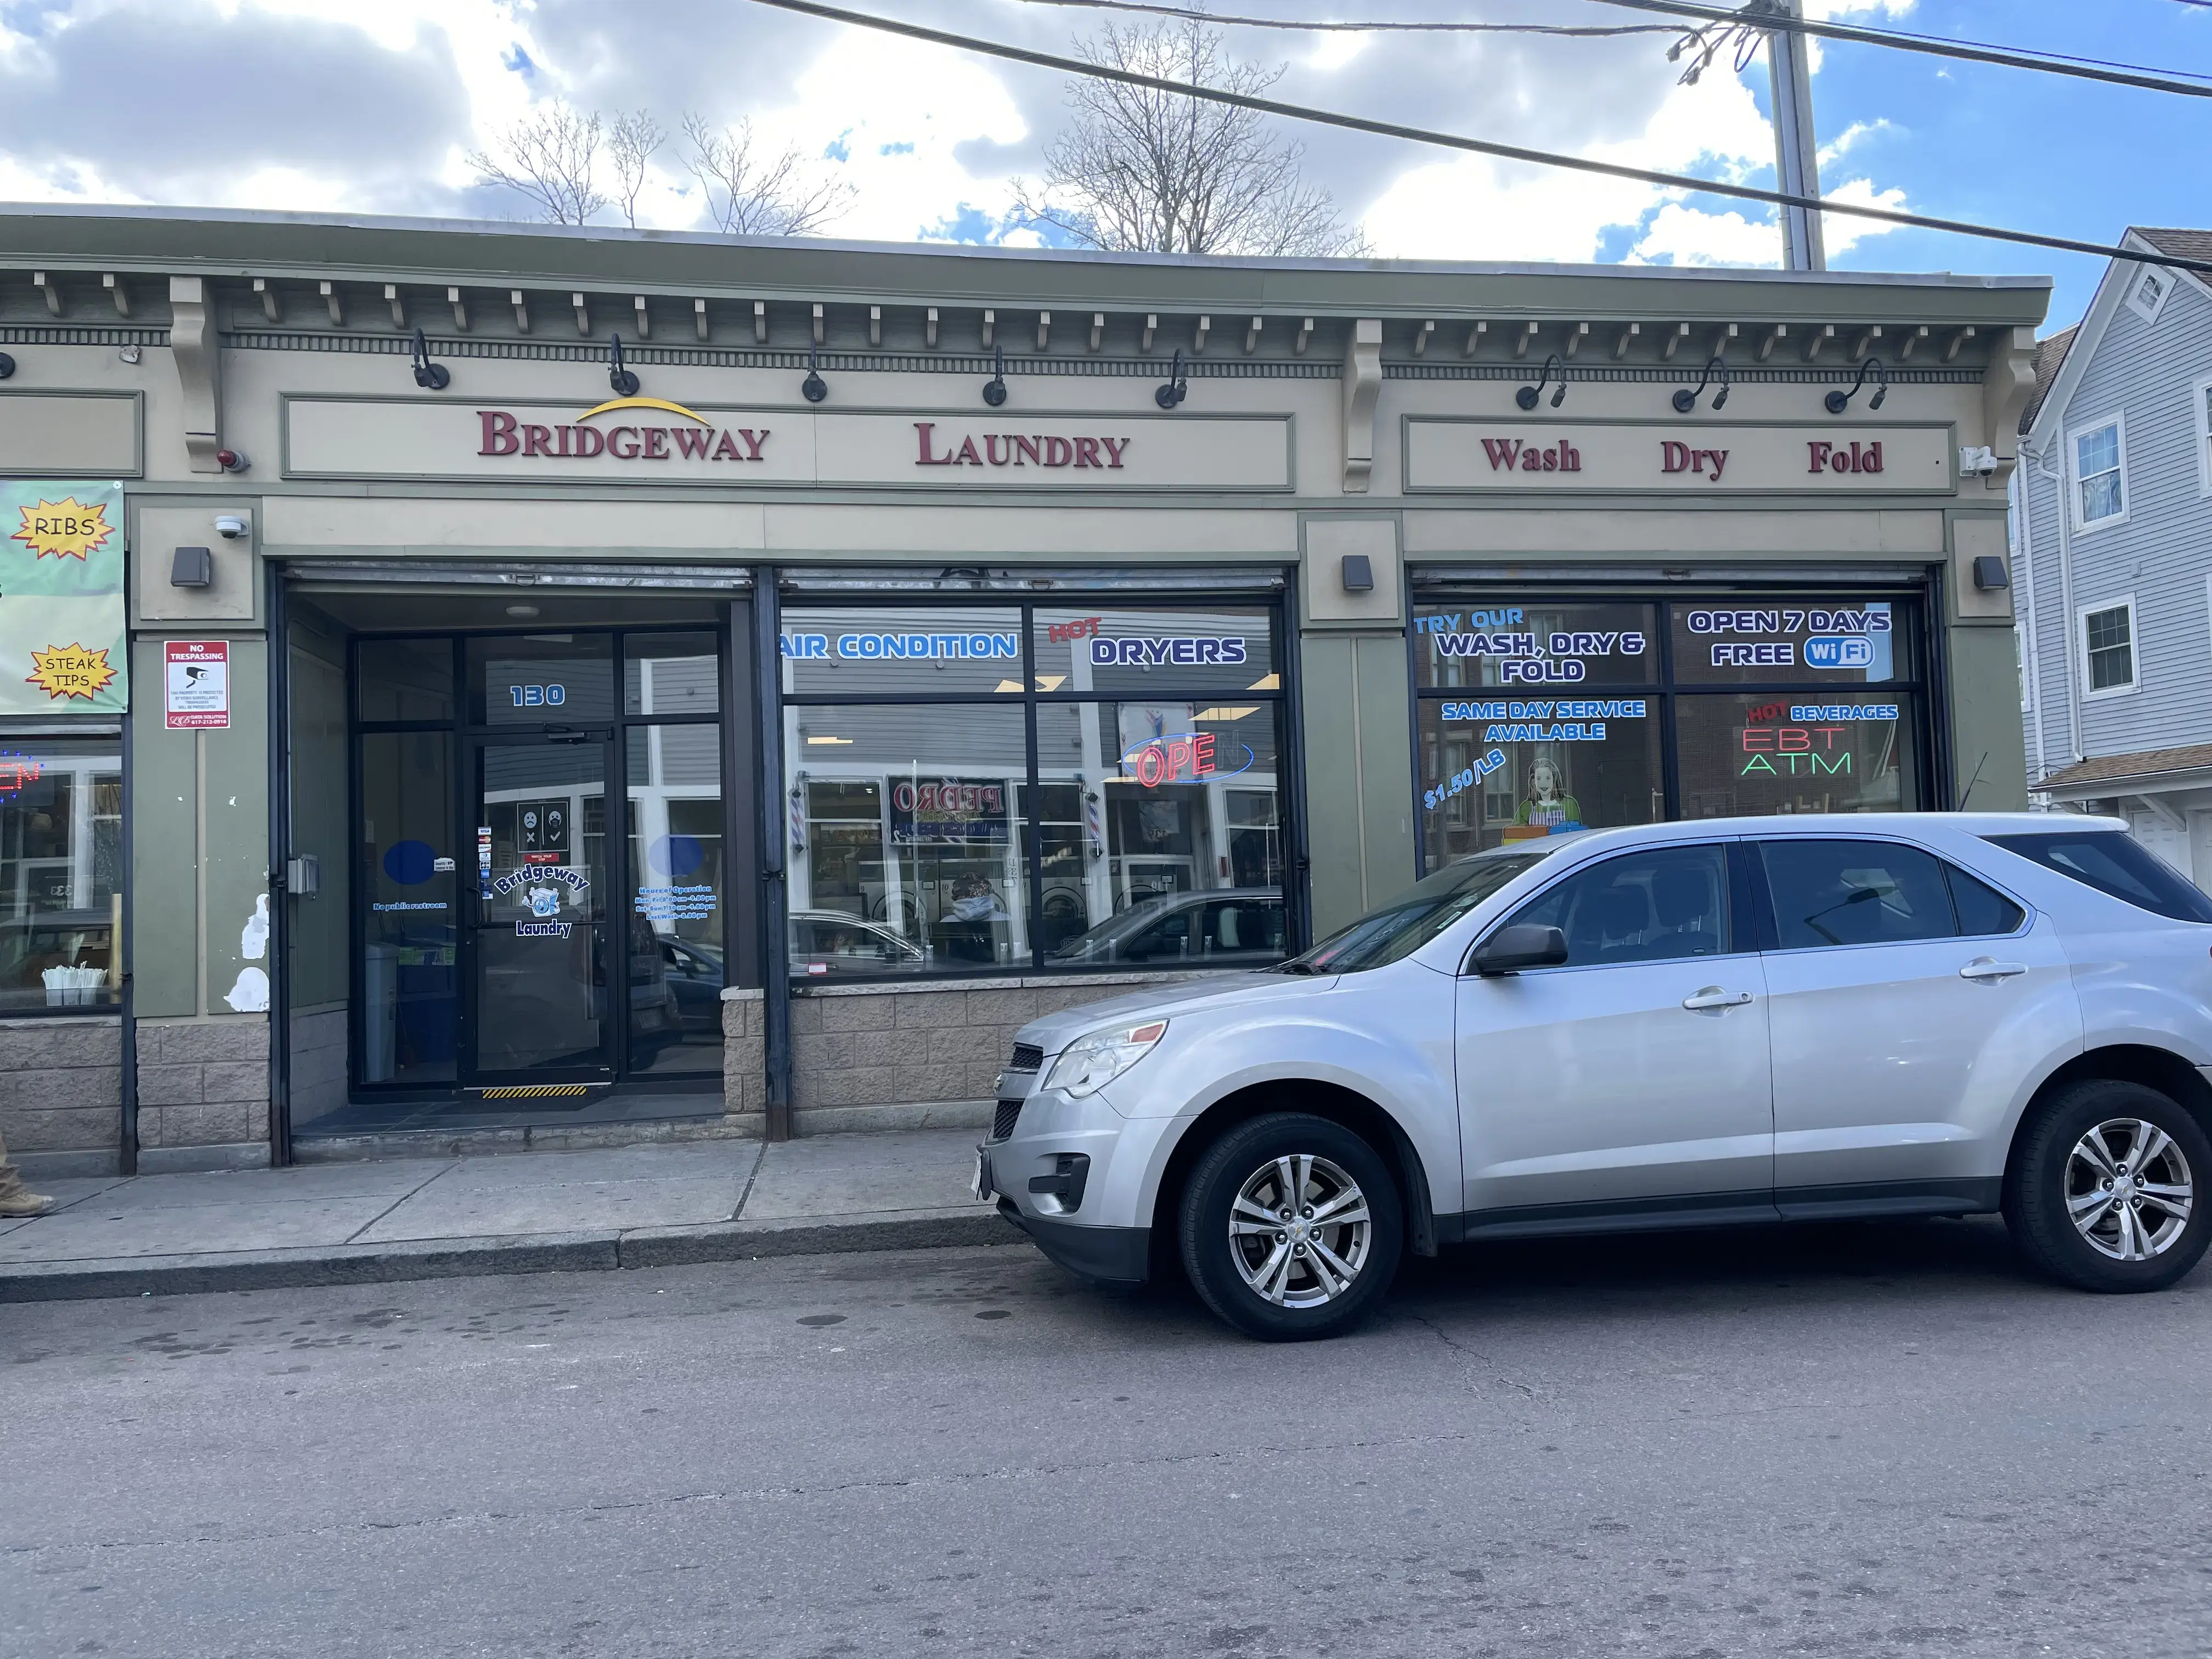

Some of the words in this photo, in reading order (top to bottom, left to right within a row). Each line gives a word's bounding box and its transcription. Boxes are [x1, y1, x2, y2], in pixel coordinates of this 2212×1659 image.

[477, 410, 770, 460] BRIDGEWAY
[913, 423, 1130, 467] LAUNDRY
[1481, 439, 1582, 471] Wash
[1660, 441, 1730, 481] Dry
[1808, 442, 1884, 473] Fold
[35, 517, 95, 536] RIBS
[1048, 617, 1102, 644] HOT
[1413, 613, 1461, 634] TRY
[1471, 608, 1523, 628] OUR
[1688, 610, 1780, 634] OPEN
[1782, 610, 1805, 633] 7
[1809, 610, 1893, 633] DAYS
[780, 633, 832, 659] AIR
[837, 633, 1018, 659] CONDITION
[1090, 637, 1246, 665] DRYERS
[1549, 631, 1618, 655] DRY
[1620, 631, 1645, 654] &
[1711, 642, 1795, 666] FREE
[45, 657, 97, 670] STEAK
[1501, 659, 1585, 683] FOLD
[53, 674, 90, 687] TIPS
[510, 684, 566, 706] 130
[1442, 702, 1506, 720] SAME
[1510, 701, 1555, 719] DAY
[1556, 700, 1646, 718] SERVICE
[1747, 701, 1788, 723] HOT
[1791, 704, 1898, 721] BEVERAGES
[1483, 723, 1606, 742] AVAILABLE
[1742, 727, 1845, 751] EBT
[1741, 752, 1851, 776] ATM
[1424, 748, 1506, 810] $1.50/LB
[494, 863, 590, 895] Bridgeway
[673, 884, 712, 895] Operation
[385, 902, 410, 911] public
[516, 918, 572, 939] Laundry
